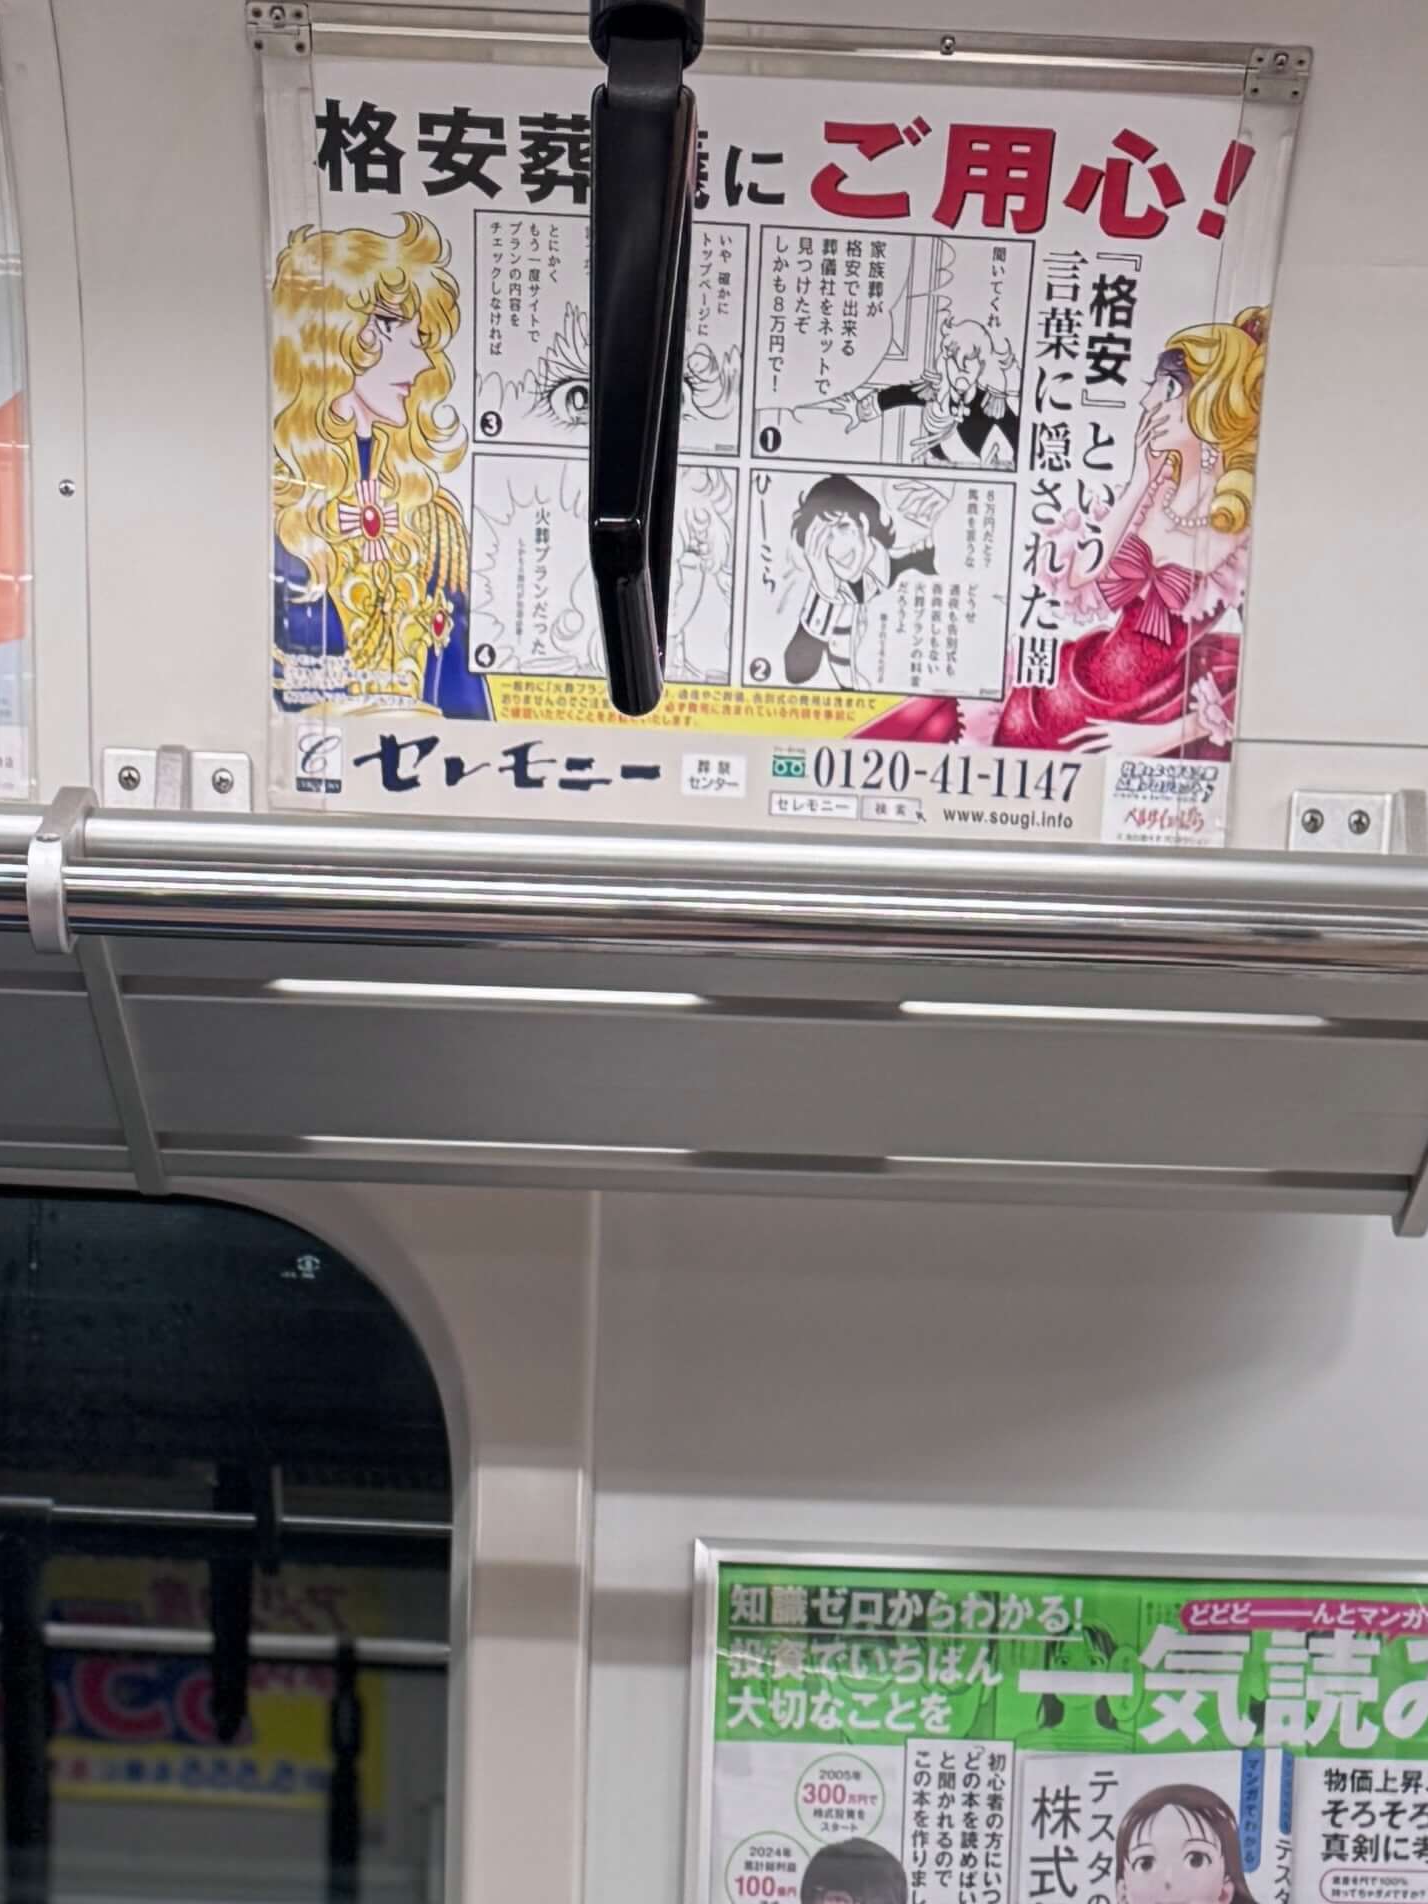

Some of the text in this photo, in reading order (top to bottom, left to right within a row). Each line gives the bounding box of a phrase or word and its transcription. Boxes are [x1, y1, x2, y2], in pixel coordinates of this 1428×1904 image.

[315, 98, 785, 207] 格安葬に
[489, 221, 503, 356] チェックしなければ
[509, 221, 523, 327] プランの内容を
[528, 223, 541, 343] もう一度サイトで
[548, 224, 561, 283] とにかく
[794, 237, 814, 334] 見つけたぞ
[866, 240, 887, 317] 家族葬が
[987, 246, 1007, 328] 聞いてくれ
[841, 239, 862, 357] 格安で出来る
[1016, 249, 1088, 689] 言葉に隠された闇
[353, 733, 662, 792] セレモニー
[814, 746, 1083, 803] 0120-41-1147
[776, 796, 850, 813] セレモニー
[942, 805, 1074, 832] www.sougi.info
[729, 1583, 1085, 1632] 知識ゼロからわかる!
[728, 1637, 1004, 1688] 投資でいちばん
[726, 1687, 953, 1735] 大切なことを
[934, 1750, 957, 1889] と聞かれるので
